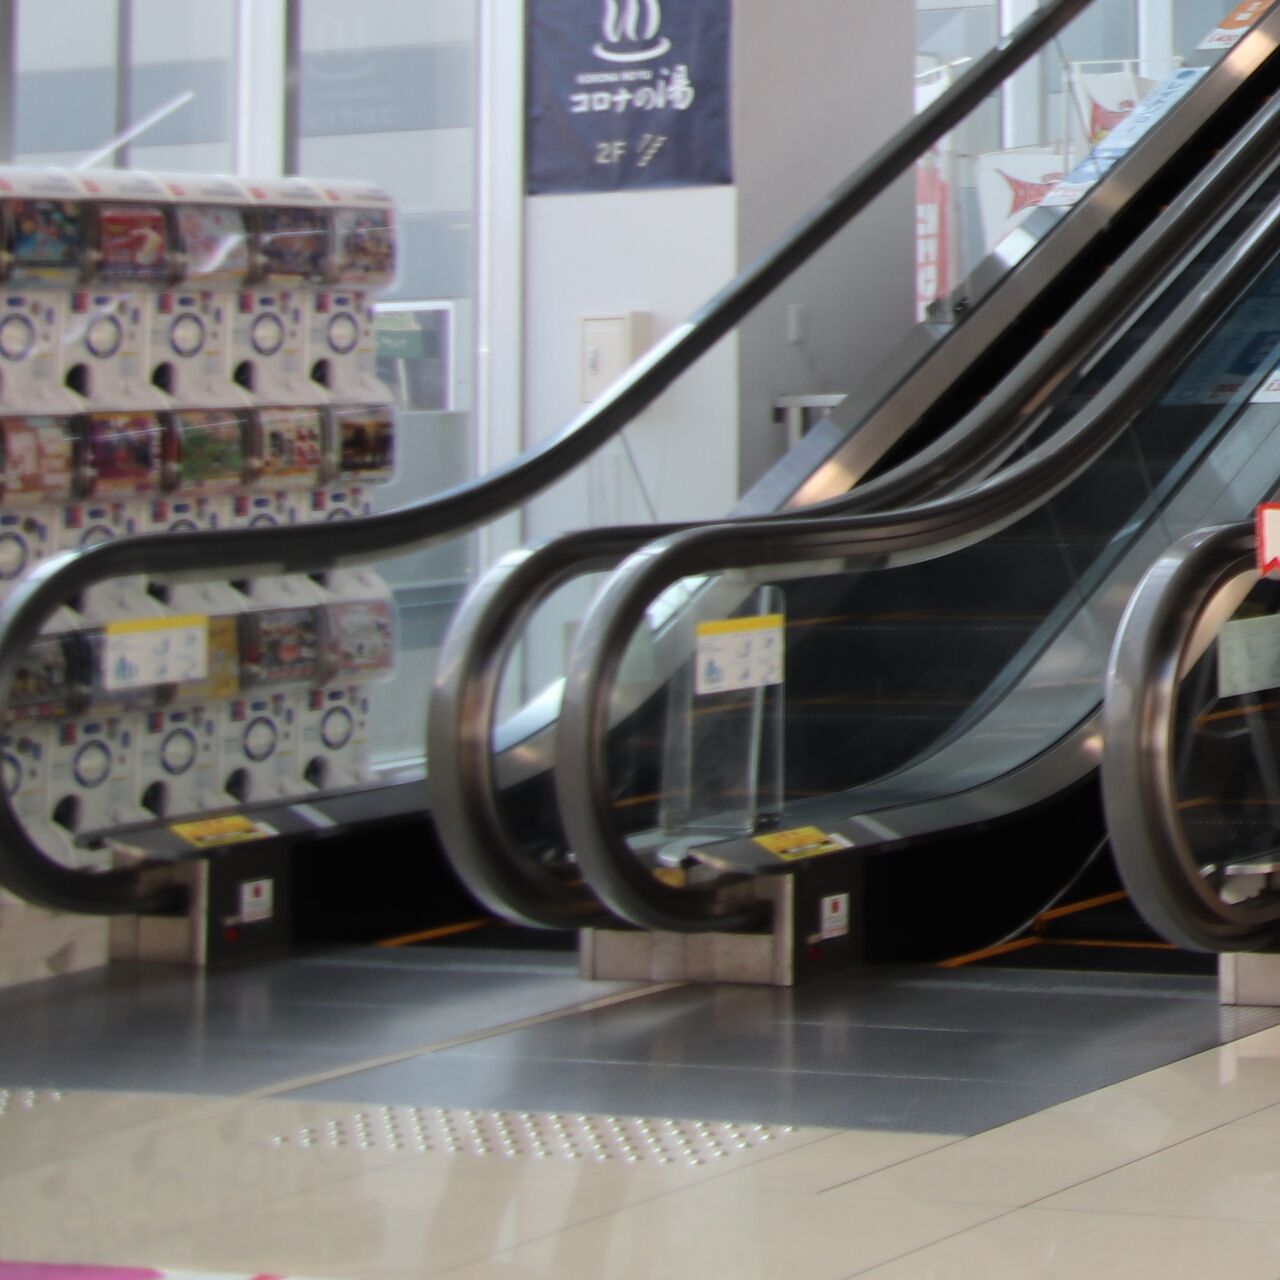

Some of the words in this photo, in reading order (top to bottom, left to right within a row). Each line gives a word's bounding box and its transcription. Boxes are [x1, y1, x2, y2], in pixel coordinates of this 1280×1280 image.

[568, 64, 696, 114] コロナの湯
[595, 141, 626, 165] 2F
